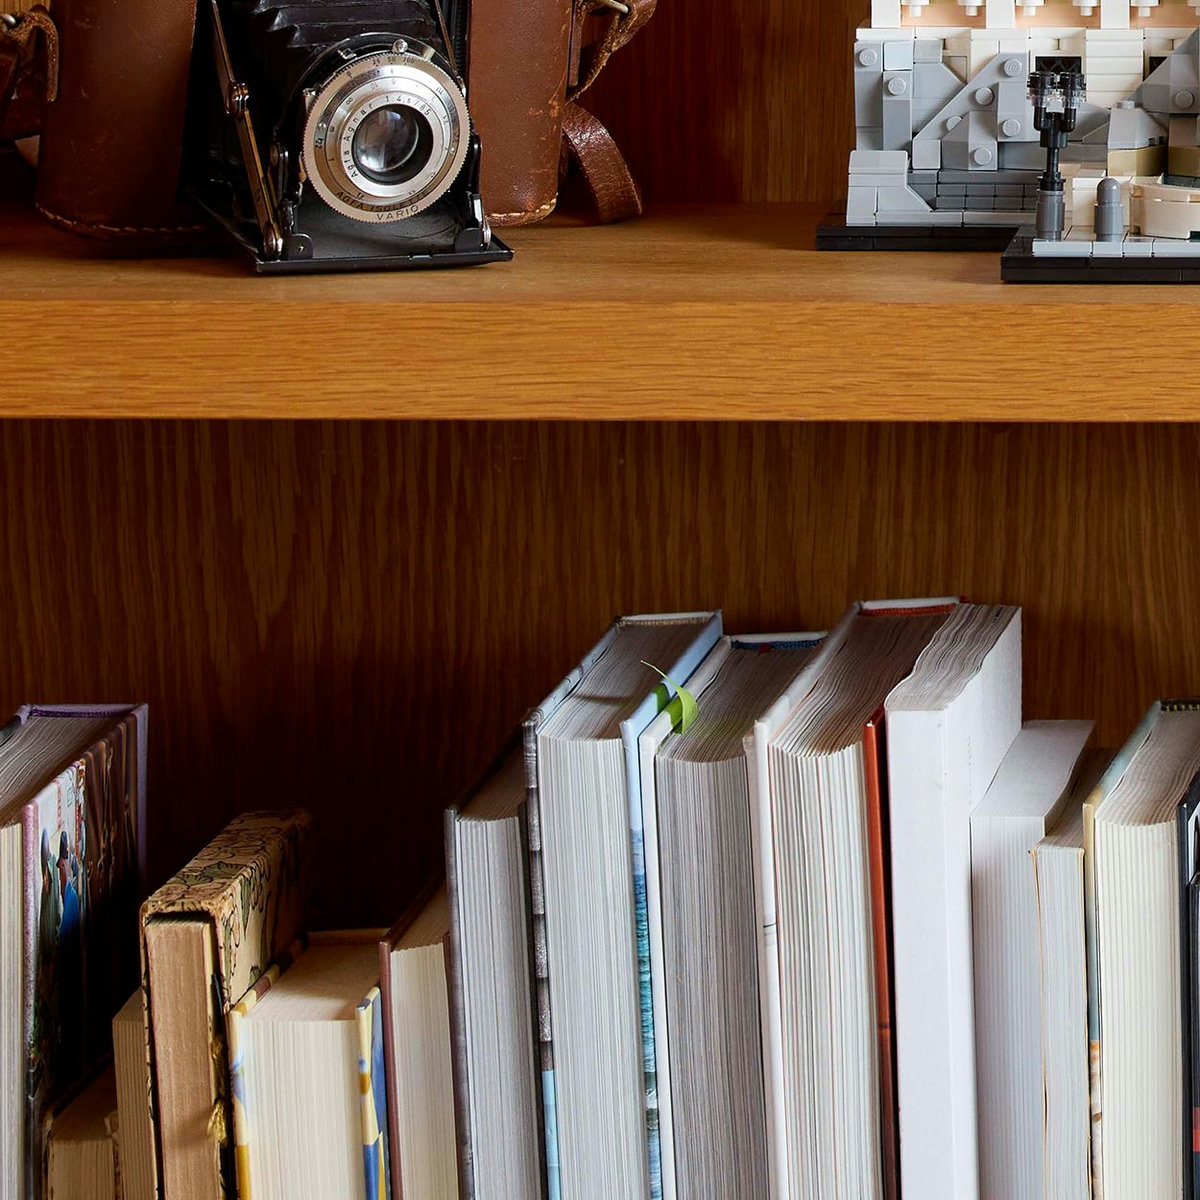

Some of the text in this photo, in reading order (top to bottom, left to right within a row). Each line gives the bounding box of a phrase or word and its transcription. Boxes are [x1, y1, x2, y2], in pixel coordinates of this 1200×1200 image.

[344, 150, 358, 178] Agfa
[336, 191, 364, 210] AGFA
[376, 204, 419, 220] VARIO
